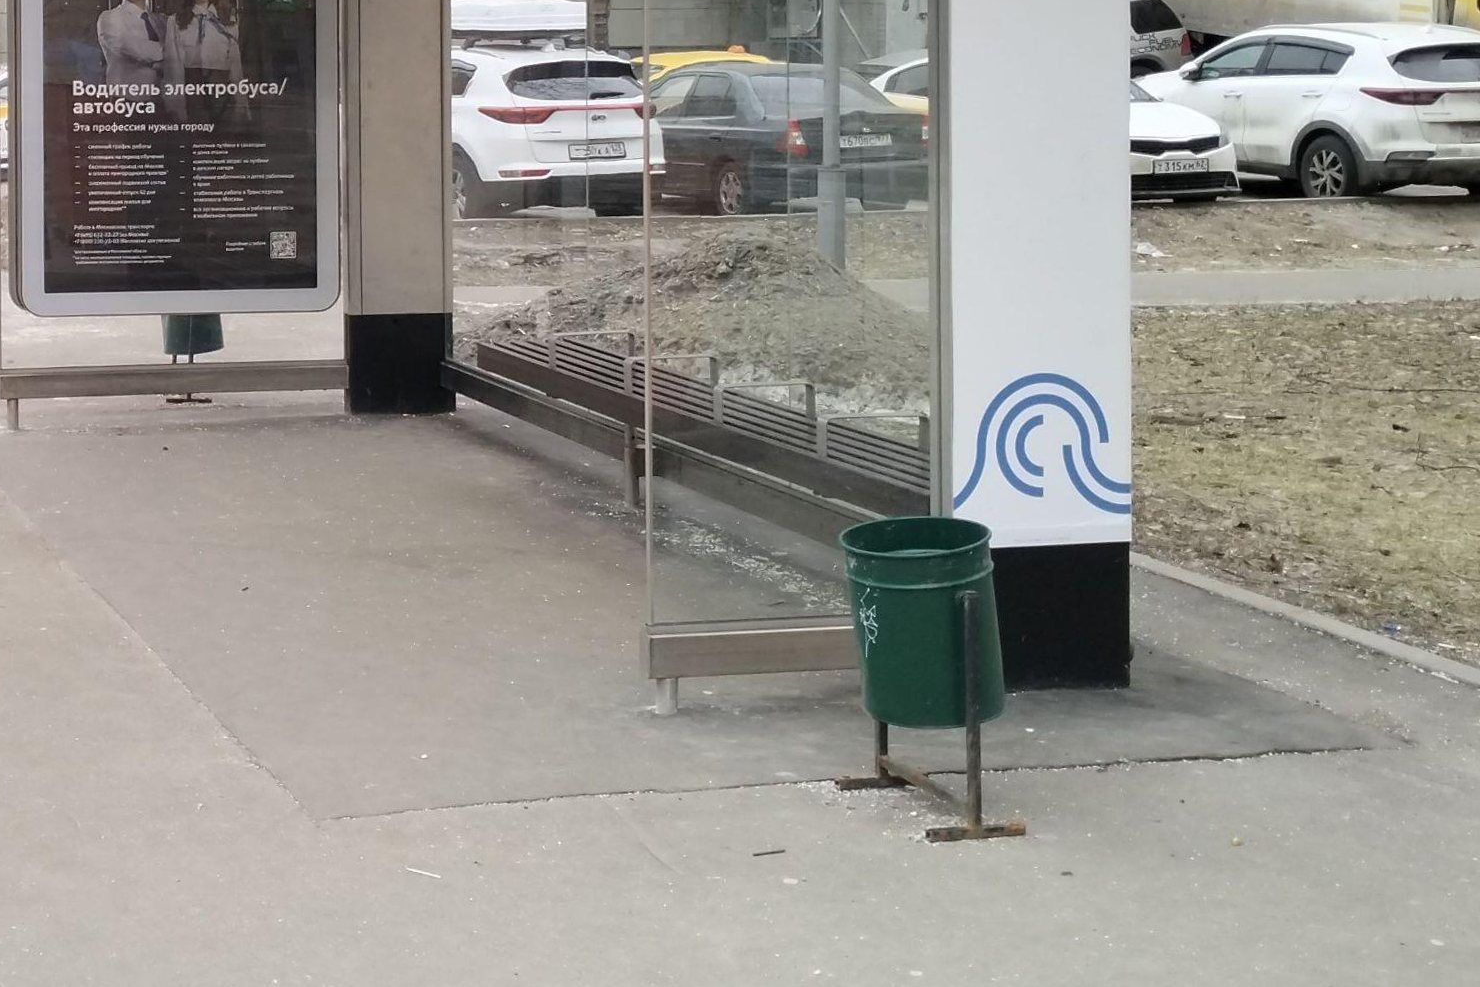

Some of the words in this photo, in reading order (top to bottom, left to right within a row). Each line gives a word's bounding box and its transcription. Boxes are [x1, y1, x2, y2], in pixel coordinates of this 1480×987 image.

[72, 80, 160, 98] Водитель
[164, 78, 288, 99] электробуса/
[72, 98, 156, 117] автобуса
[73, 123, 90, 132] Эта
[92, 122, 146, 134] профессия
[148, 123, 179, 134] нужна
[181, 122, 215, 133] городу
